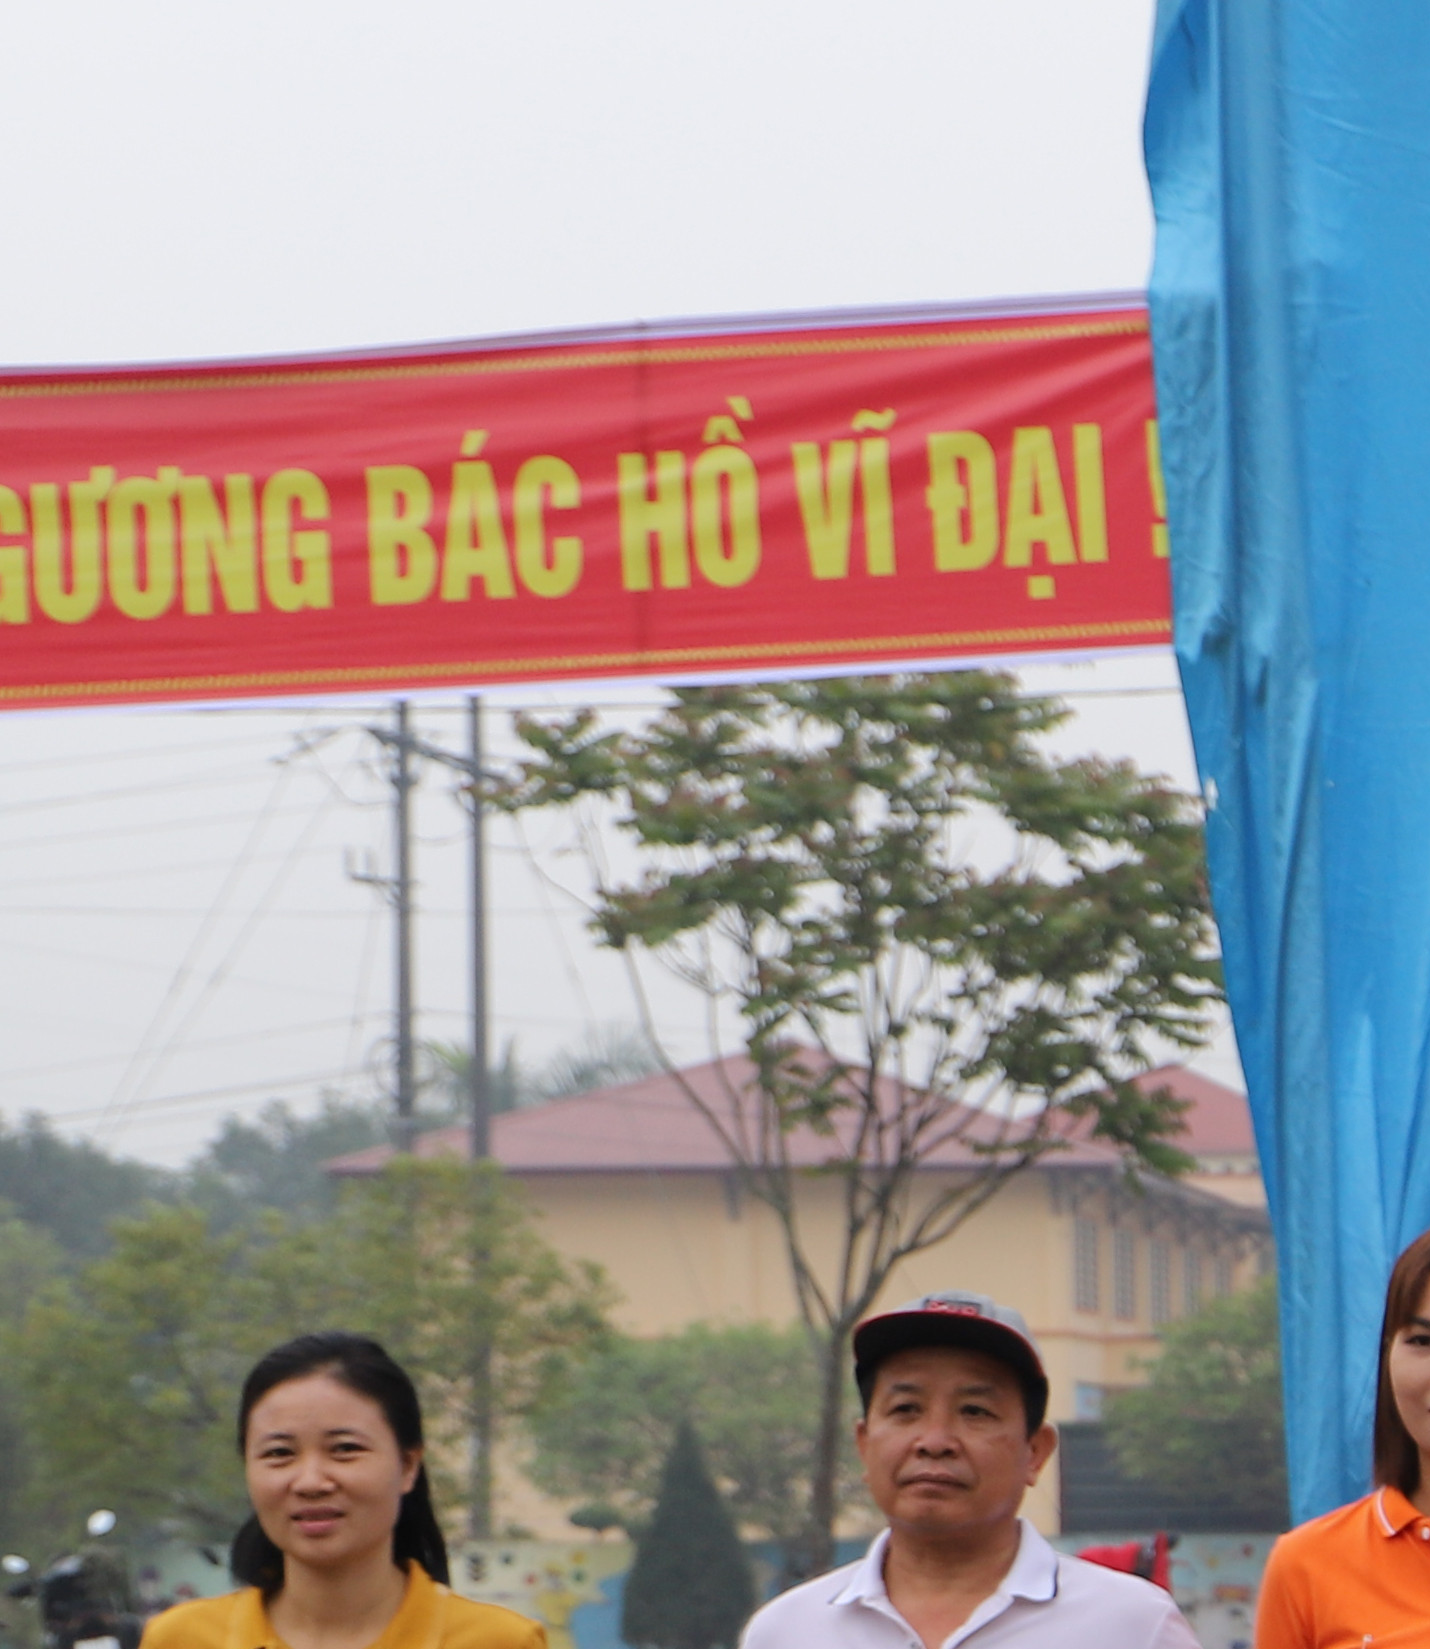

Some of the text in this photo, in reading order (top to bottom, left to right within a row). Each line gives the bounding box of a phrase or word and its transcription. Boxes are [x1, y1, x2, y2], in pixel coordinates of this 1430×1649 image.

[365, 430, 582, 605] BÁC
[618, 396, 760, 590] HỒ
[791, 409, 894, 579] VĨ
[926, 423, 1107, 598] ĐẠI
